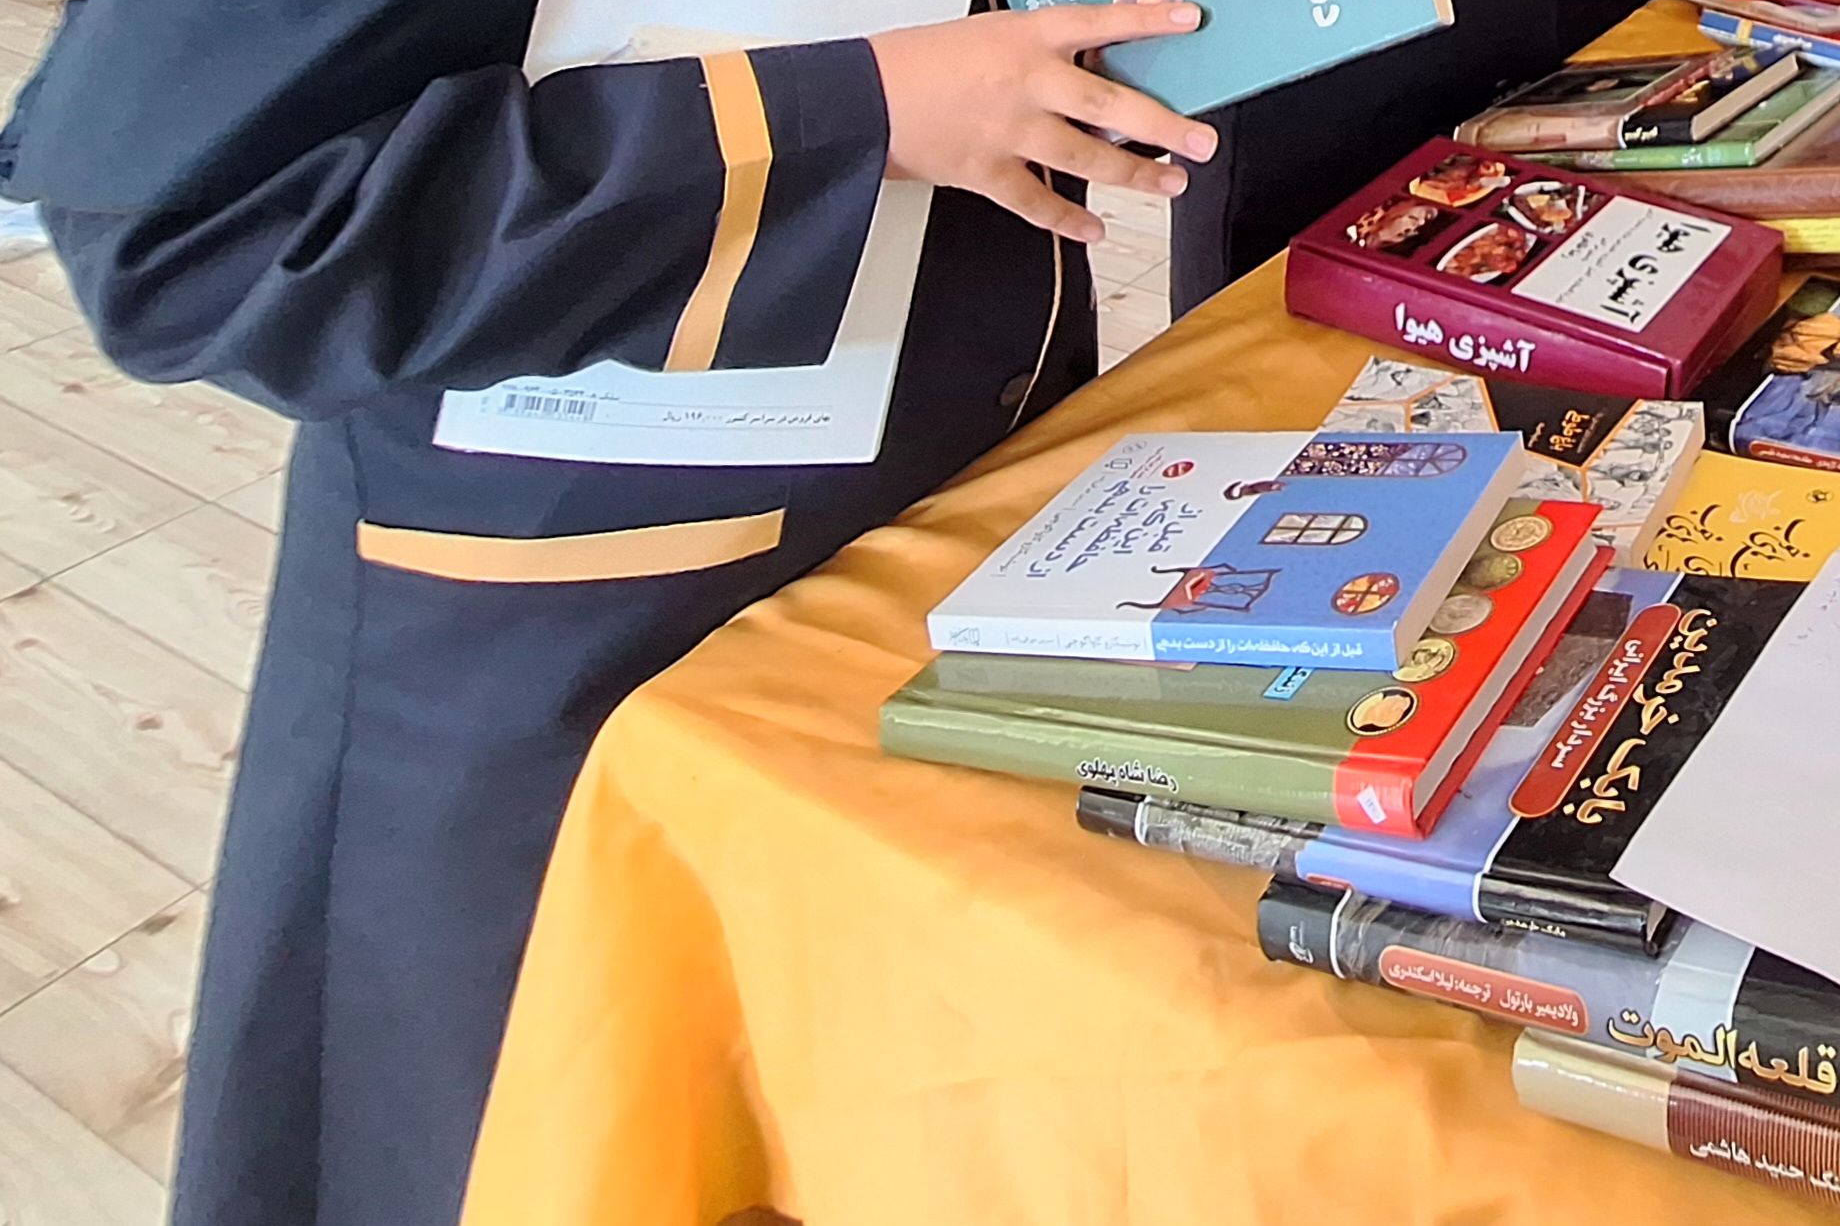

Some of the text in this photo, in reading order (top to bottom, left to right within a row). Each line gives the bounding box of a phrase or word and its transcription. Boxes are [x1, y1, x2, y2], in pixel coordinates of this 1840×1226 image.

[1599, 252, 1661, 325] آشپزی
[1655, 221, 1712, 254] هیوا
[1394, 301, 1537, 374] آشپزی هیوا
[1025, 559, 1052, 578] از
[1044, 515, 1099, 563] دست
[1147, 502, 1204, 554] قبل از
[1343, 640, 1364, 656] قبل
[1550, 638, 1645, 770] سردار بزرگ ایرانی
[1562, 607, 1719, 825] بابک خرمدین
[1076, 757, 1179, 793] رضا شاه پهلوی
[1387, 961, 1436, 984] اسکندری
[1434, 971, 1454, 992] لیلا
[1499, 988, 1580, 1027] ولادیمیر بارتول
[1606, 1005, 1840, 1098] قلعه الموت
[1688, 1137, 1751, 1167] هاشمی
[1754, 1153, 1805, 1180] حمید
